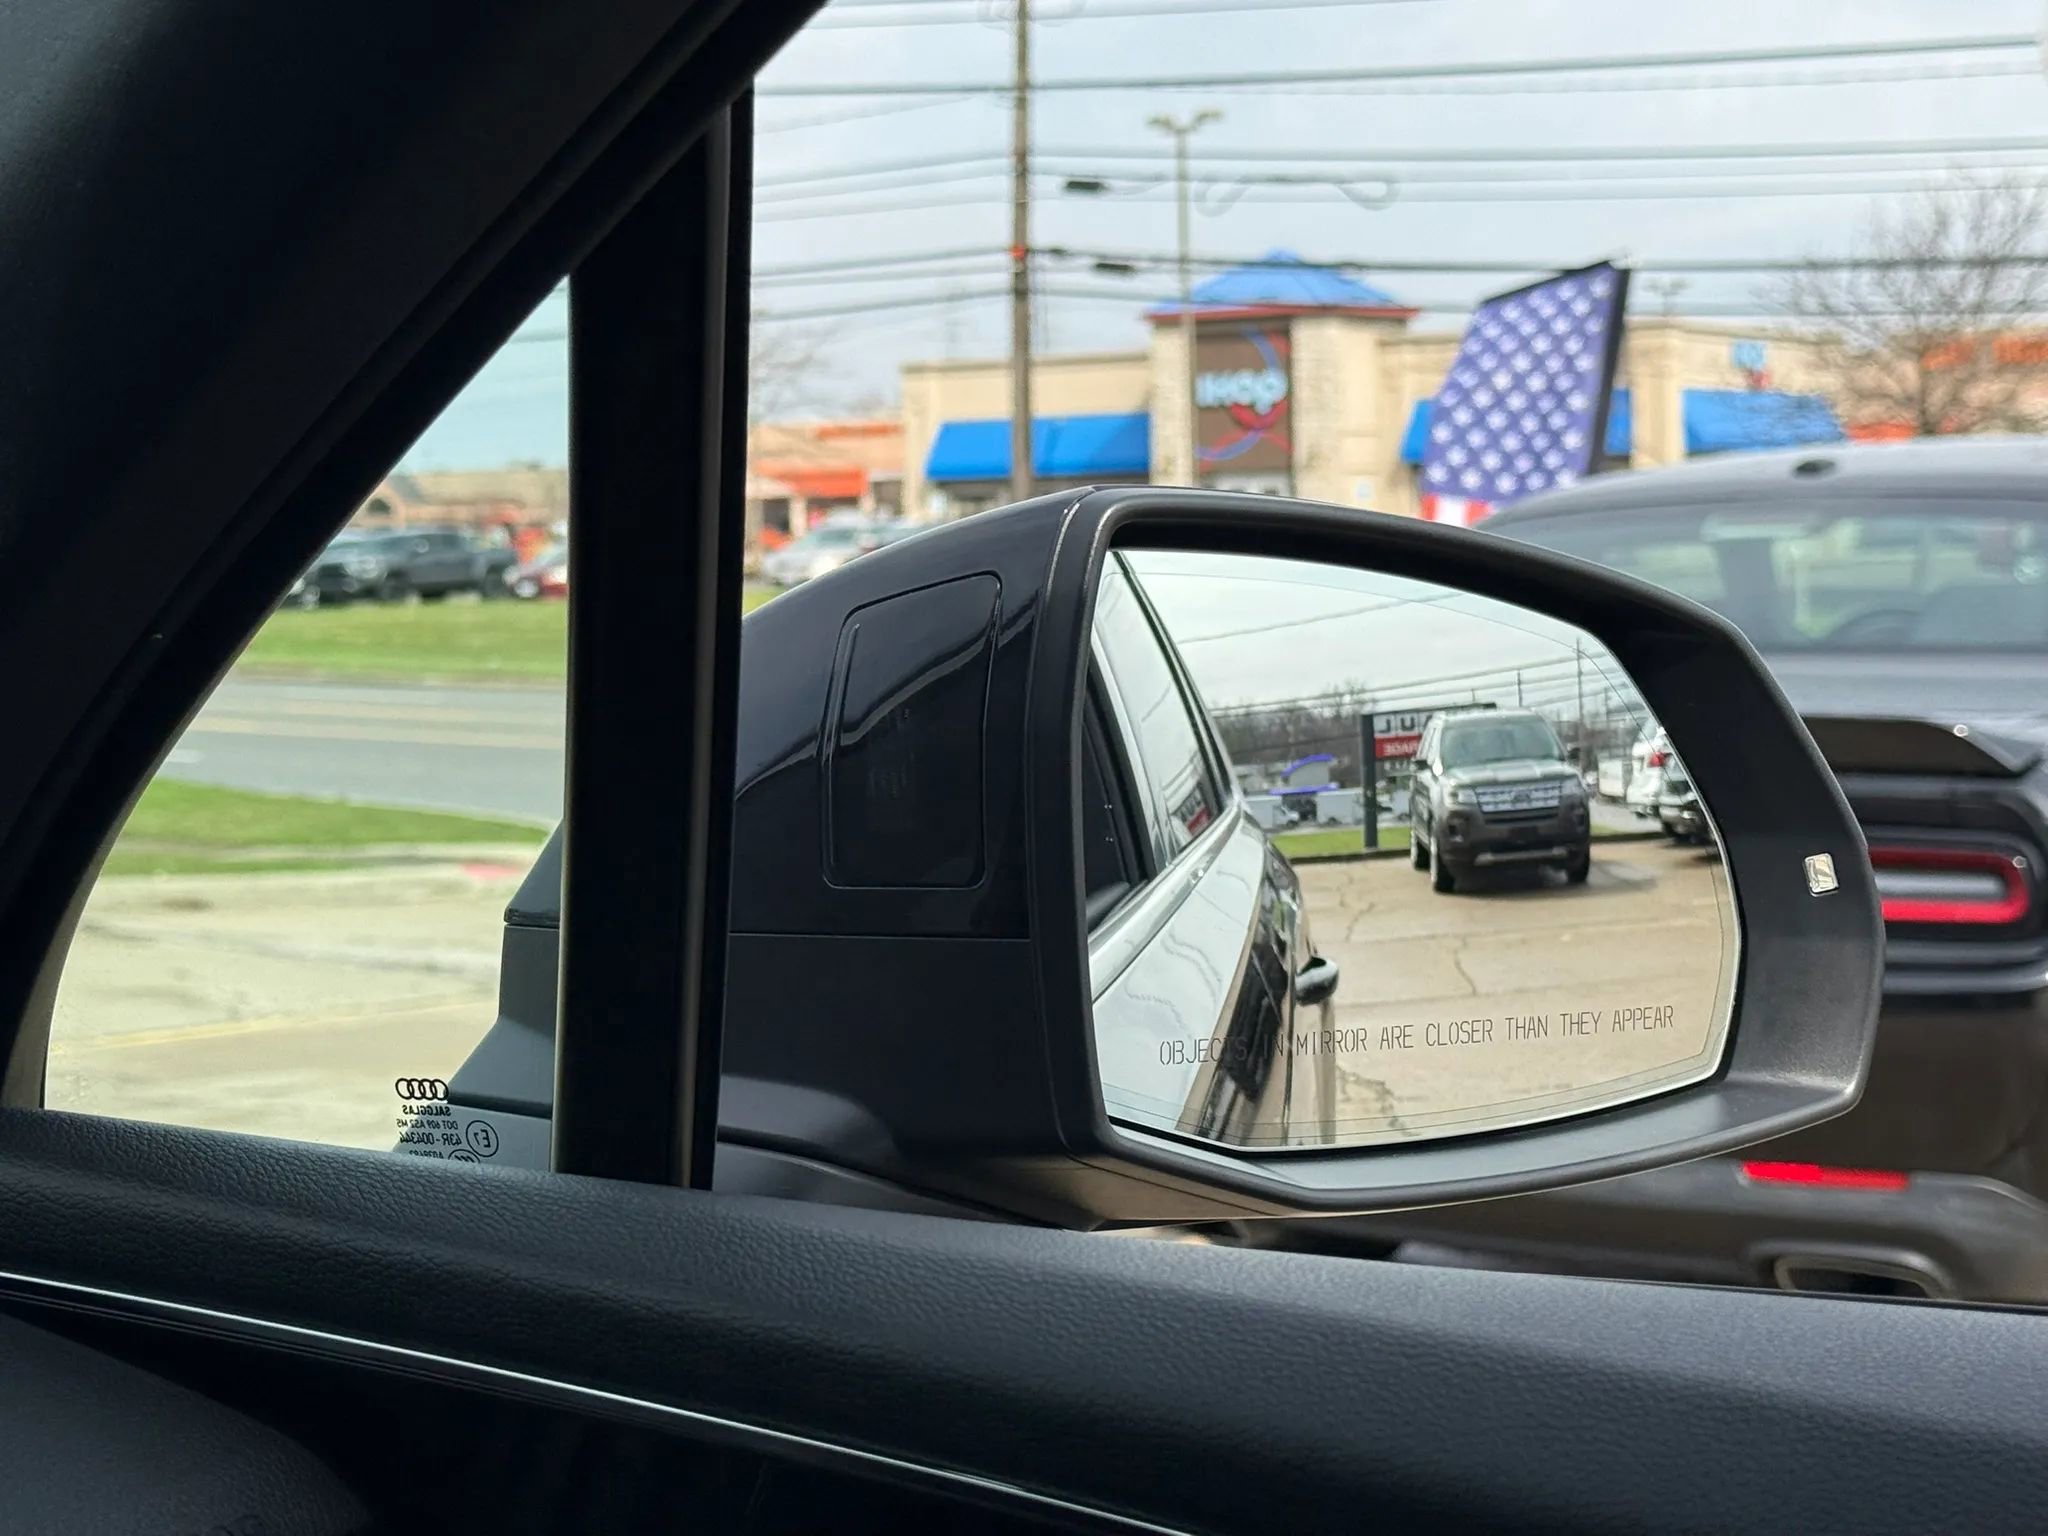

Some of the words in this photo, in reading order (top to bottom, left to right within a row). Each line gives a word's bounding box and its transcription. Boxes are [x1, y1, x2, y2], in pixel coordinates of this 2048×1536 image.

[1159, 1037, 1249, 1065] OBJECTS
[1263, 1033, 1284, 1059] IN
[1296, 1028, 1367, 1056] MIRROR
[1380, 1025, 1414, 1050] ARE
[1426, 1019, 1493, 1047] CLOSER
[1505, 1014, 1549, 1040] THAN
[1560, 1011, 1602, 1037] THEY
[1612, 1005, 1674, 1033] APPEAR
